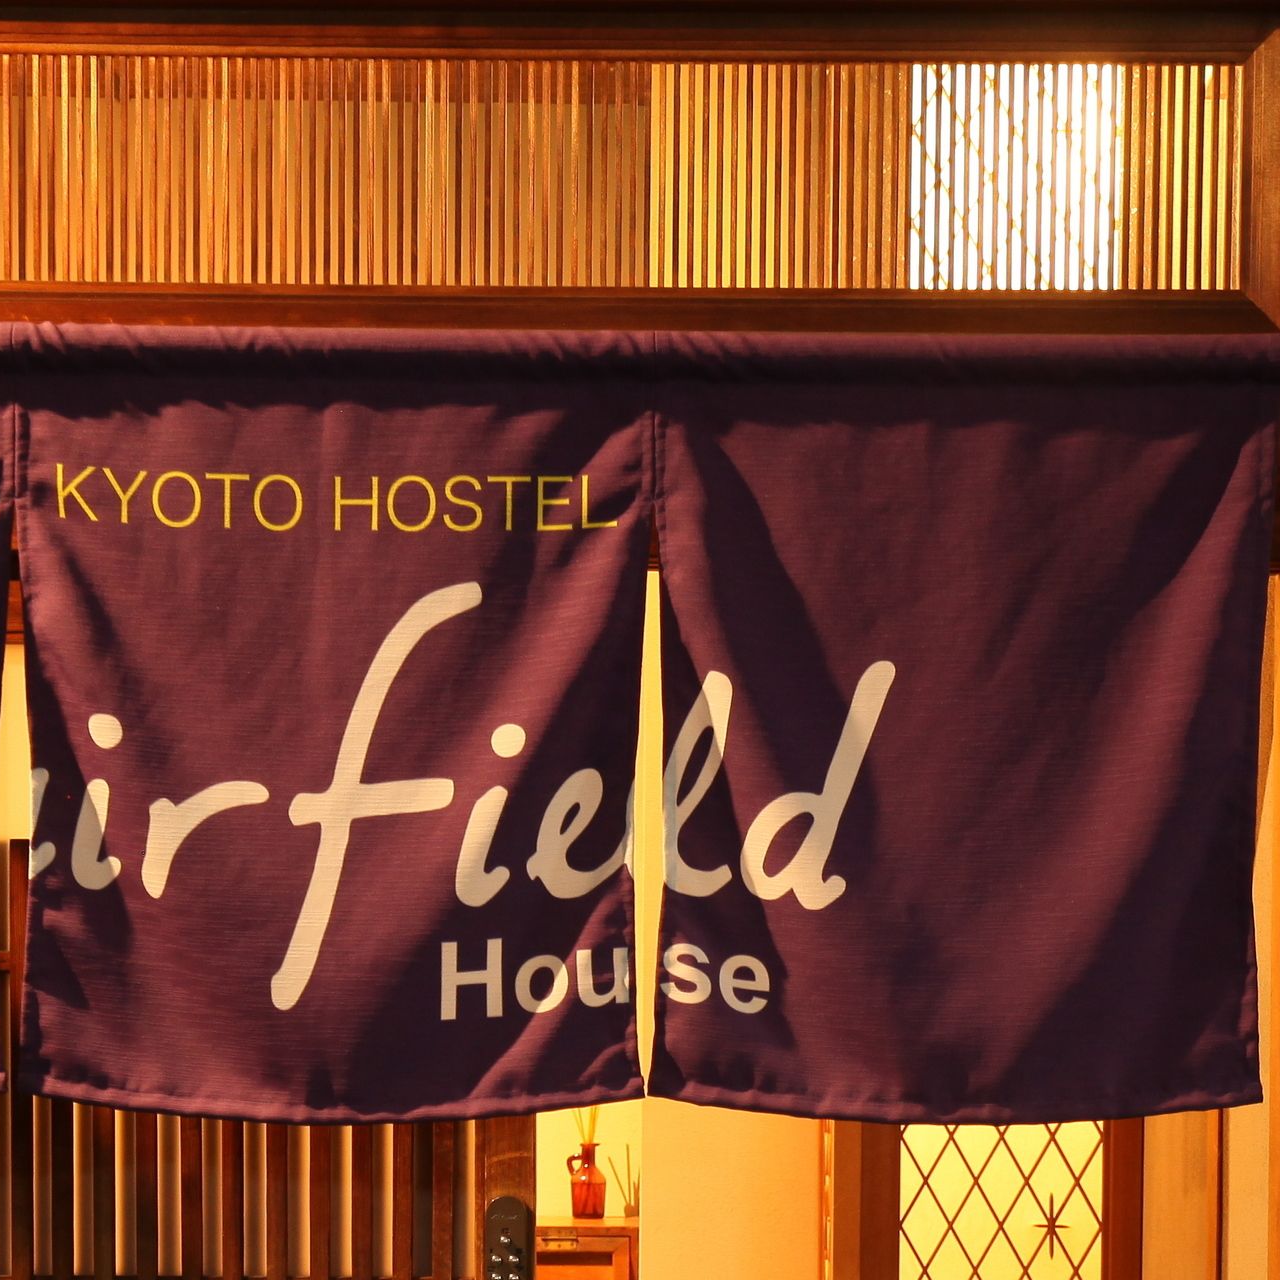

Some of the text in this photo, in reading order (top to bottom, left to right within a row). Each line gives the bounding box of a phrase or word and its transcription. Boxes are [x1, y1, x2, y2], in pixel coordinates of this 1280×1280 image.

[55, 463, 618, 532] KYOTO HOSTEL
[439, 935, 772, 1021] House
